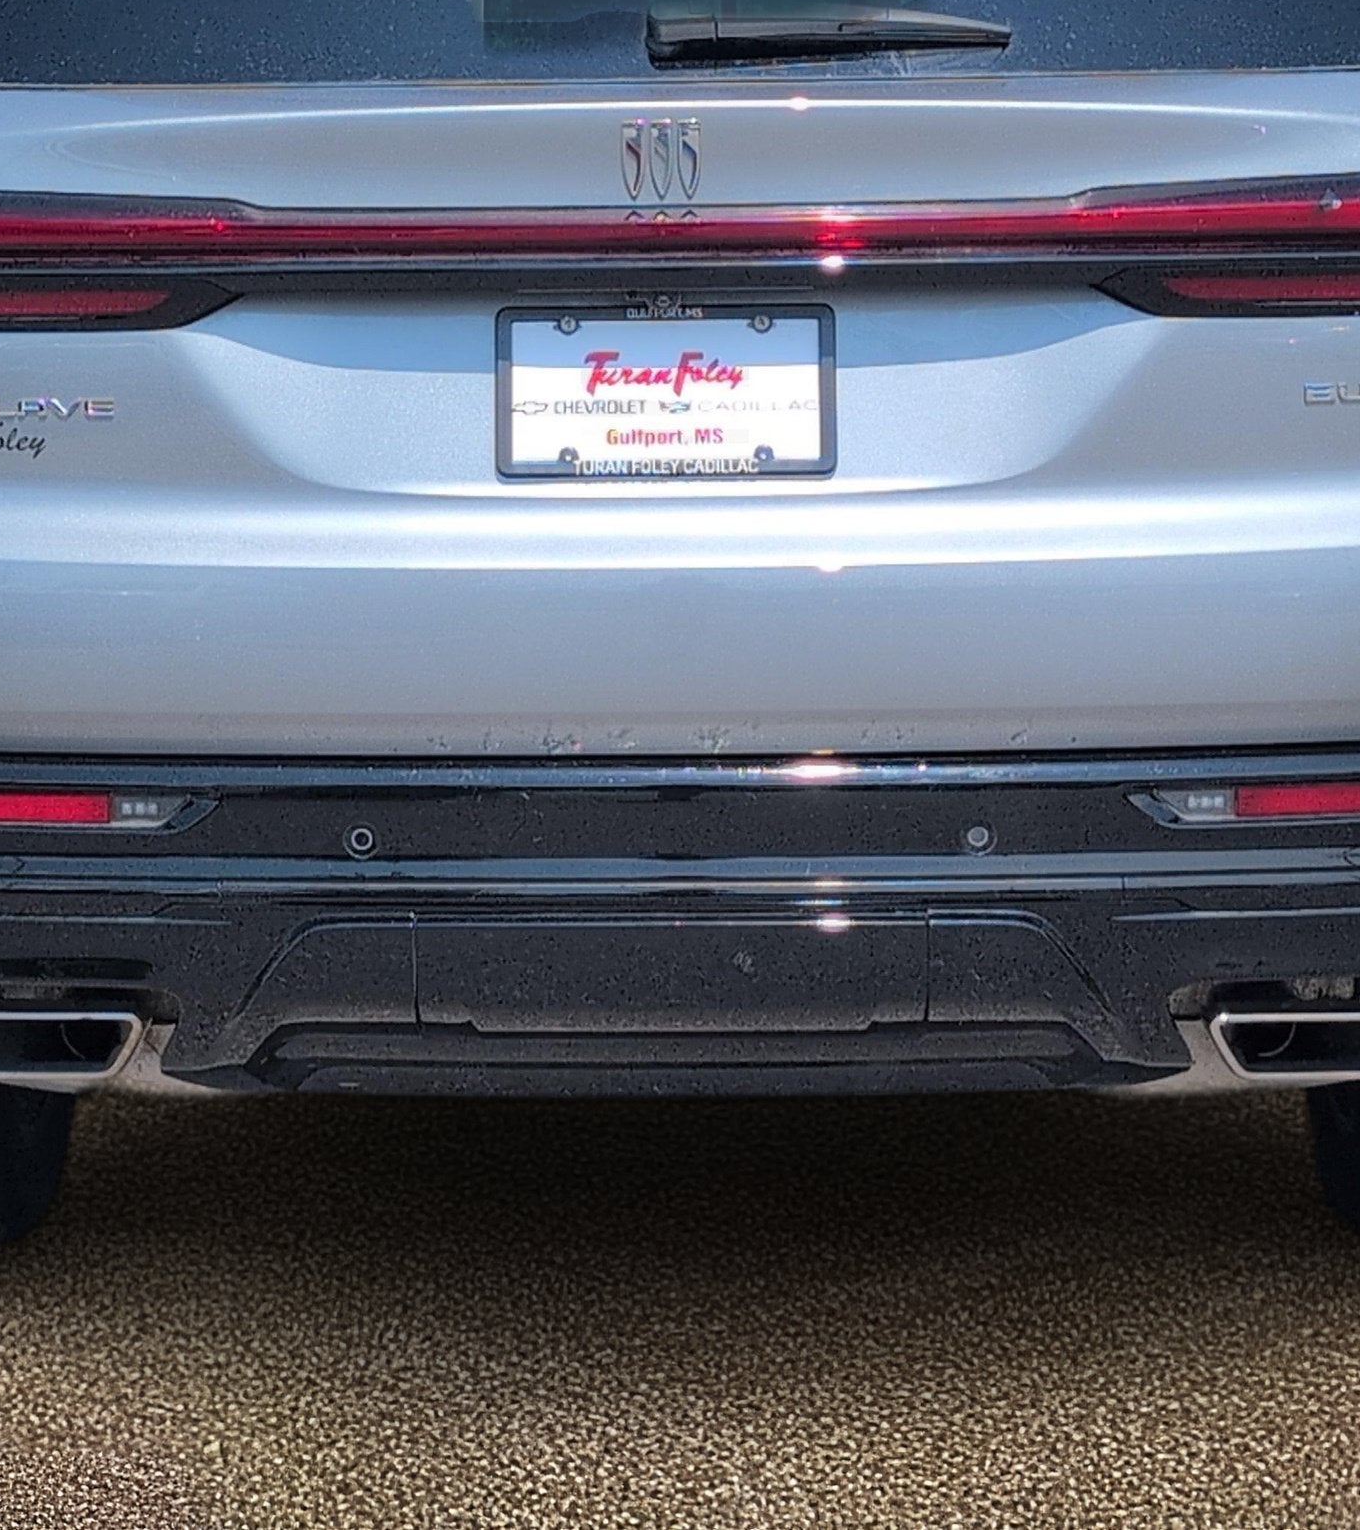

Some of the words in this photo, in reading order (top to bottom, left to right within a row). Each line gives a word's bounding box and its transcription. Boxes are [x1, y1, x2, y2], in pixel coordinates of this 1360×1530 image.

[554, 399, 646, 414] CHEVROLET
[694, 428, 724, 445] MS
[573, 458, 628, 476] TURAN
[631, 458, 680, 476] FOLEY
[684, 457, 760, 475] CADILLAC
